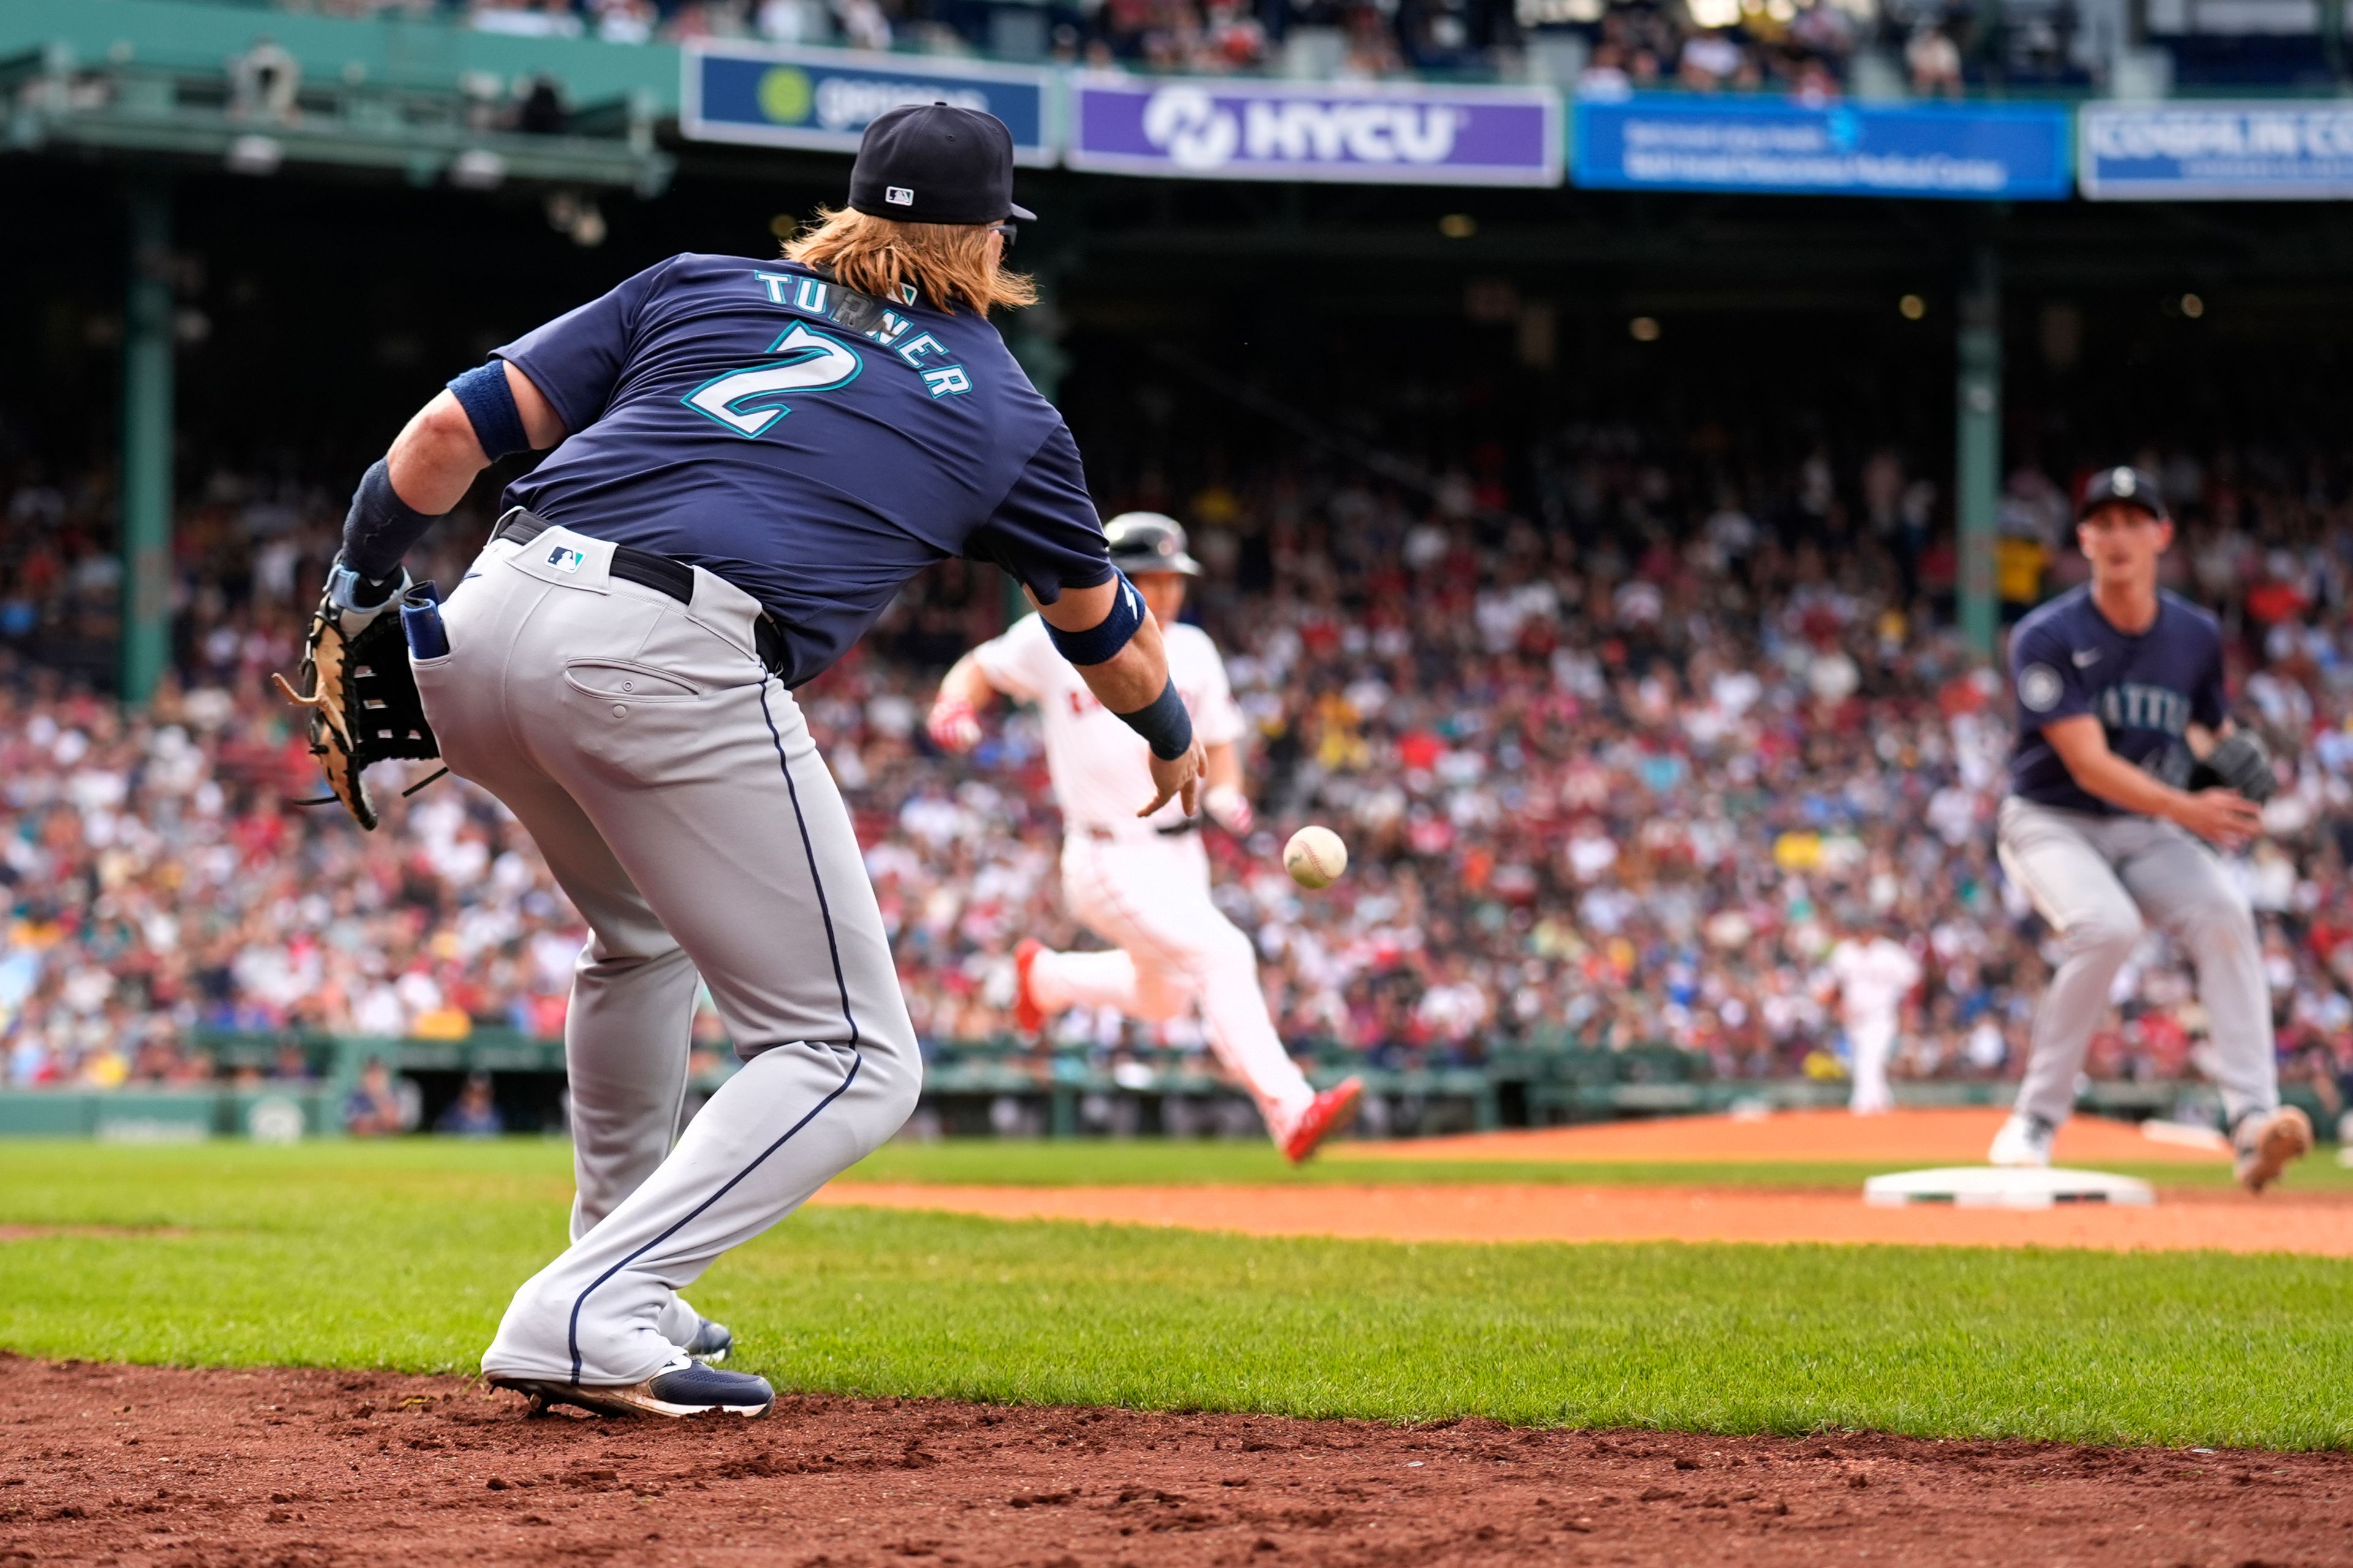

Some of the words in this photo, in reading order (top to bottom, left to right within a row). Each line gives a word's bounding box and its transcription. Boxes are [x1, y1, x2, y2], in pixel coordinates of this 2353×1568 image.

[1244, 97, 1456, 164] HYCU
[680, 319, 863, 439] 2
[754, 270, 973, 399] TURNER
